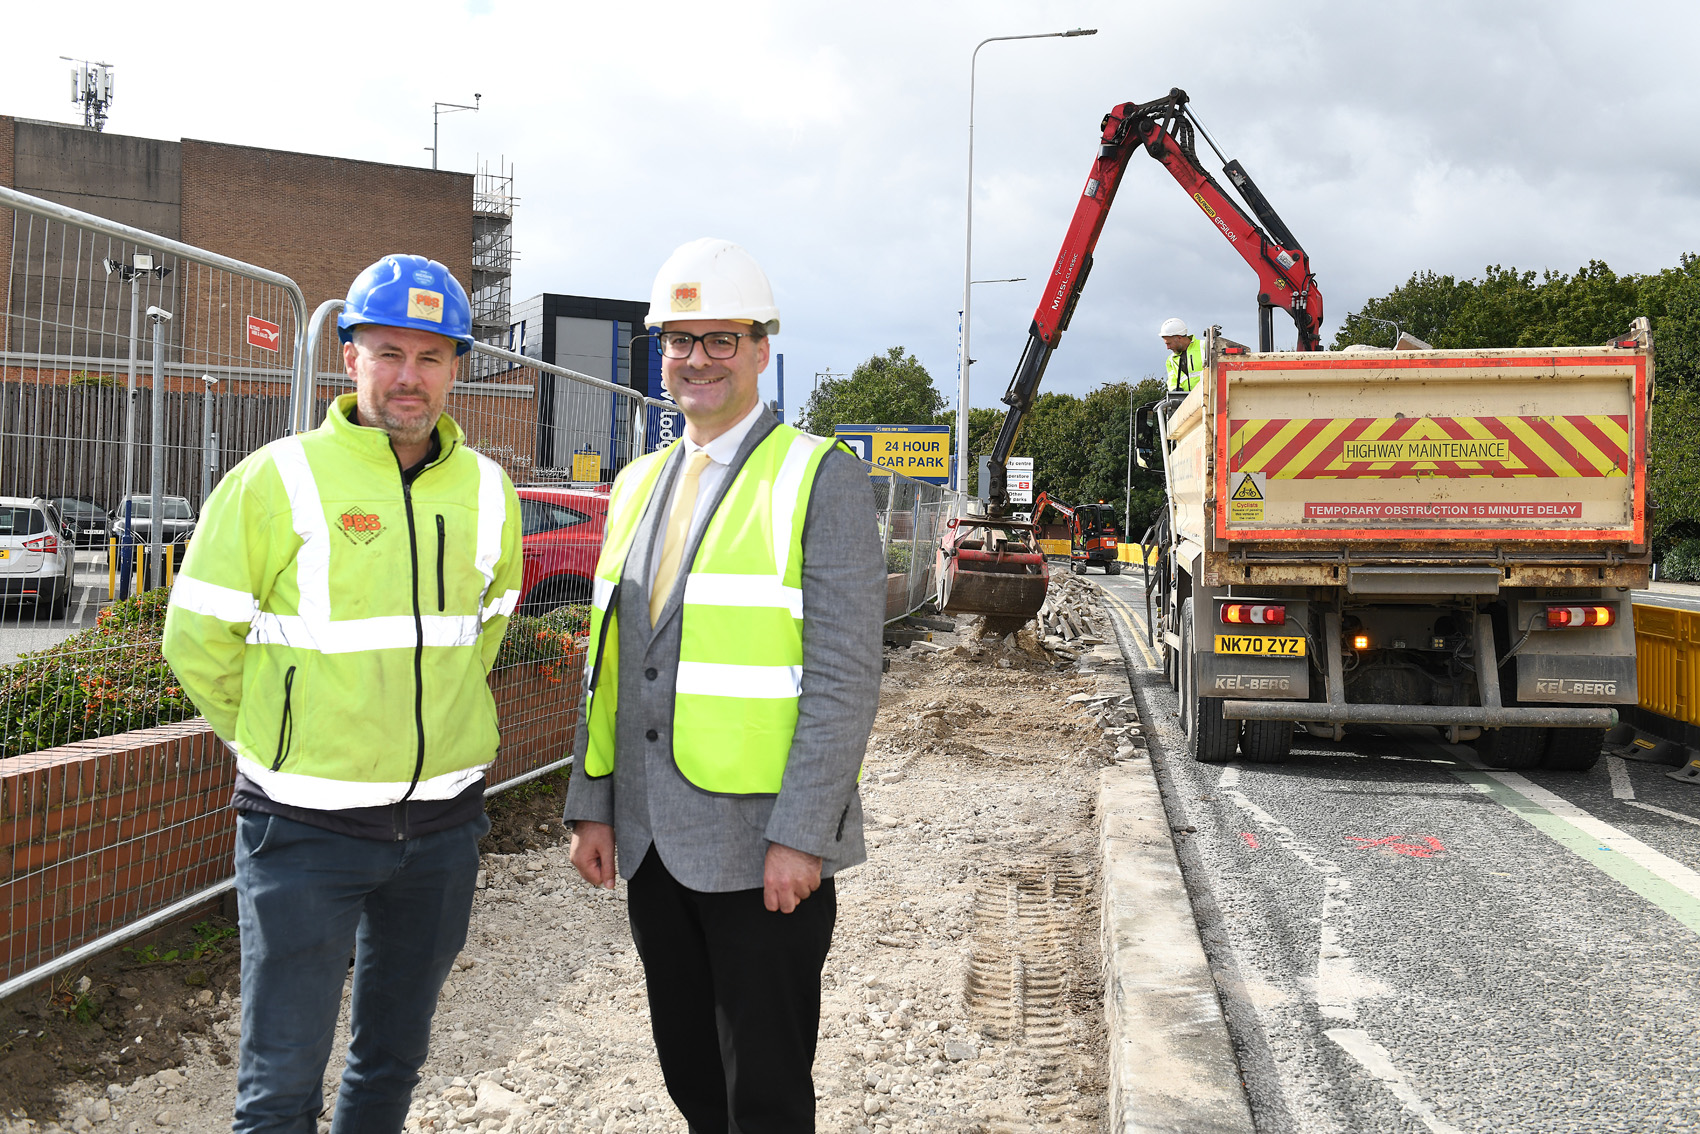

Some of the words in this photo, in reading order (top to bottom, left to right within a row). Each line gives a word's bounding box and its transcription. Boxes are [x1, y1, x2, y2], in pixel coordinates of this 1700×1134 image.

[1214, 216, 1238, 242] EPSILON
[1065, 253, 1079, 279] CLASSIC
[416, 293, 440, 309] PBS
[676, 287, 698, 300] PBS
[885, 441, 899, 452] 24
[903, 441, 940, 452] HOUR
[1346, 443, 1404, 458] HIGHWAY
[1408, 442, 1505, 458] MAINTENANCE
[877, 456, 904, 467] CAR
[908, 456, 944, 468] PARK
[1309, 506, 1382, 515] TEMPORARY
[1384, 505, 1469, 515] OBSTRUCTION
[1472, 505, 1485, 515] 15
[1488, 505, 1534, 515] MINUTE
[1537, 505, 1577, 515] DELAY
[1221, 637, 1263, 653] NK70
[1267, 638, 1299, 654] ZYZ
[1214, 675, 1290, 690] KEL-BERG
[1535, 679, 1617, 696] KEL-BERG
